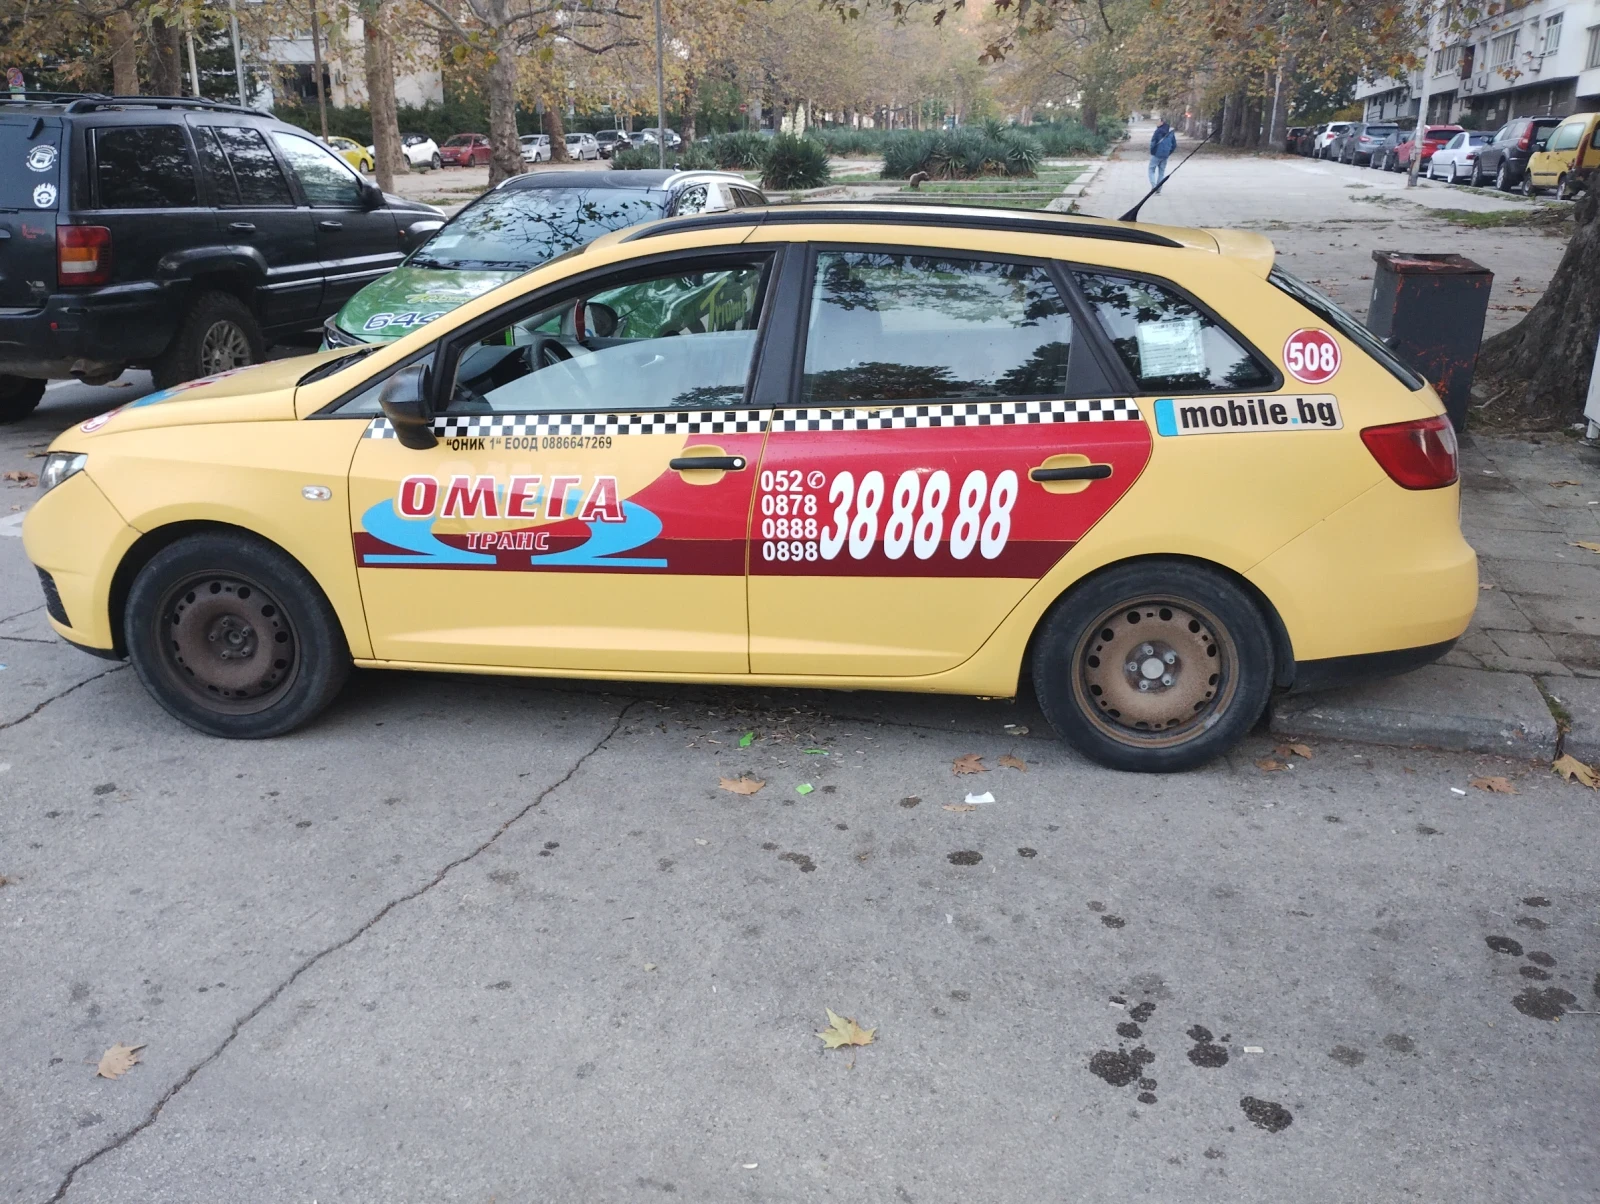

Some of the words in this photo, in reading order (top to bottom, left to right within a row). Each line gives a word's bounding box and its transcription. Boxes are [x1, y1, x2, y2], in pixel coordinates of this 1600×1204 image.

[1288, 342, 1335, 371] 508
[1180, 398, 1337, 429] mobile.bg
[505, 437, 539, 452] ЕООД
[542, 435, 612, 450] 0886647269
[760, 469, 804, 492] 052
[397, 474, 627, 522] ОМЕГА
[761, 494, 818, 516] 0878
[761, 518, 818, 539] 0888
[466, 531, 550, 550] ТРАНС
[762, 541, 818, 561] 0898
